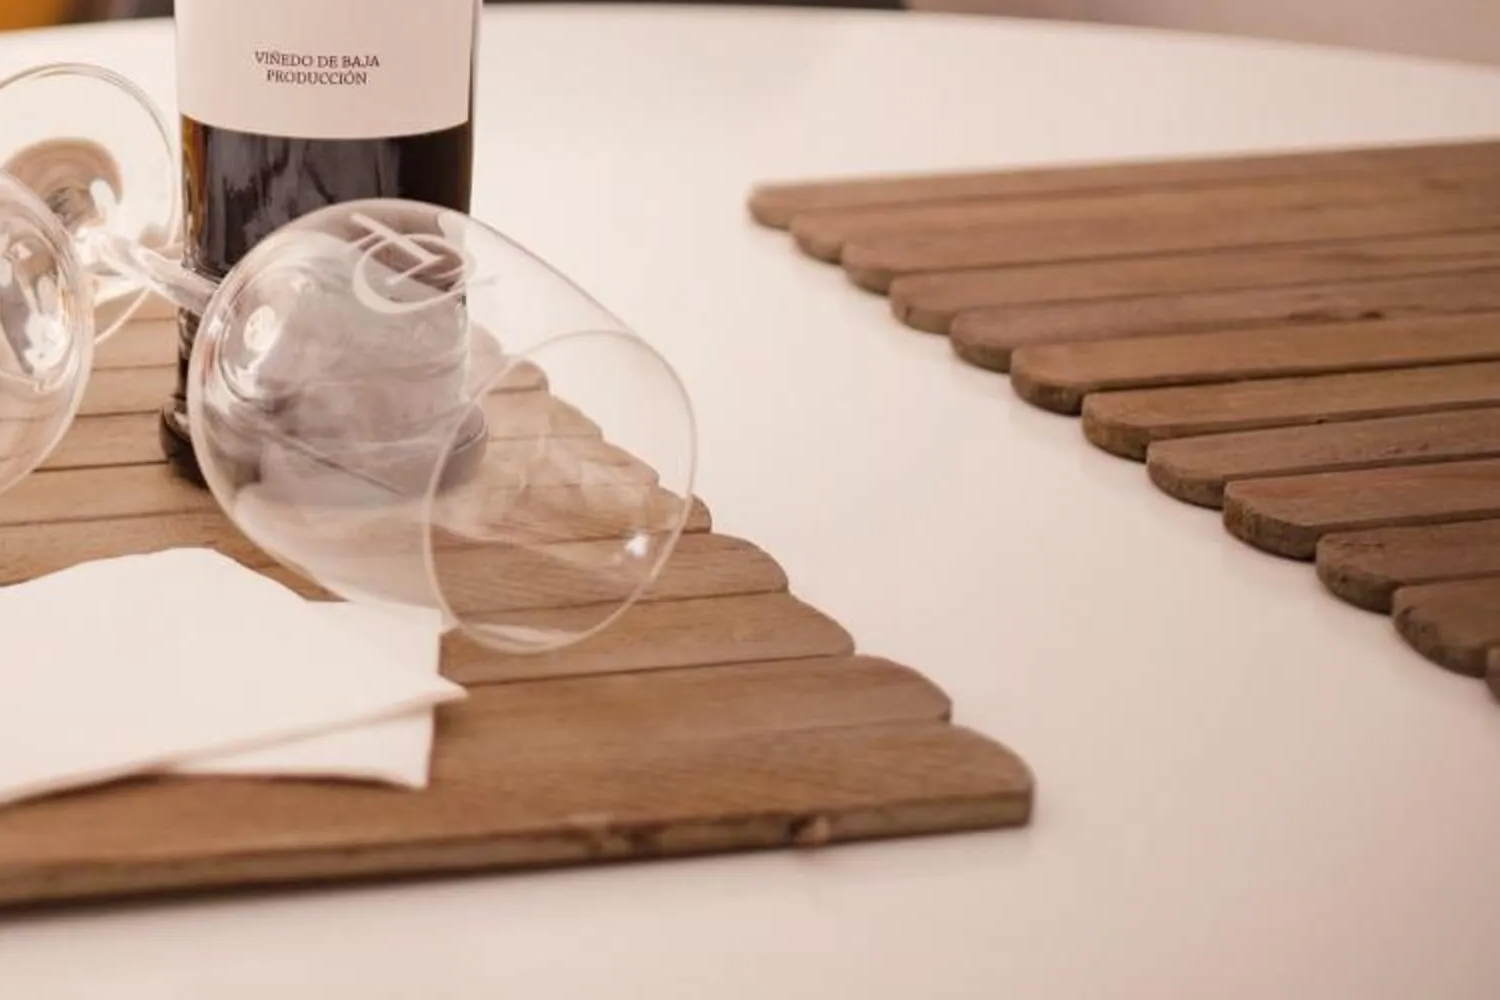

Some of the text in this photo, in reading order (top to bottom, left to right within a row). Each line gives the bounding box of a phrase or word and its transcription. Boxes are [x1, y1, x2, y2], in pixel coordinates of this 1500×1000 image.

[254, 50, 380, 69] VIÑEDO DE BAJA
[266, 69, 368, 85] PRODUCCIÓN
